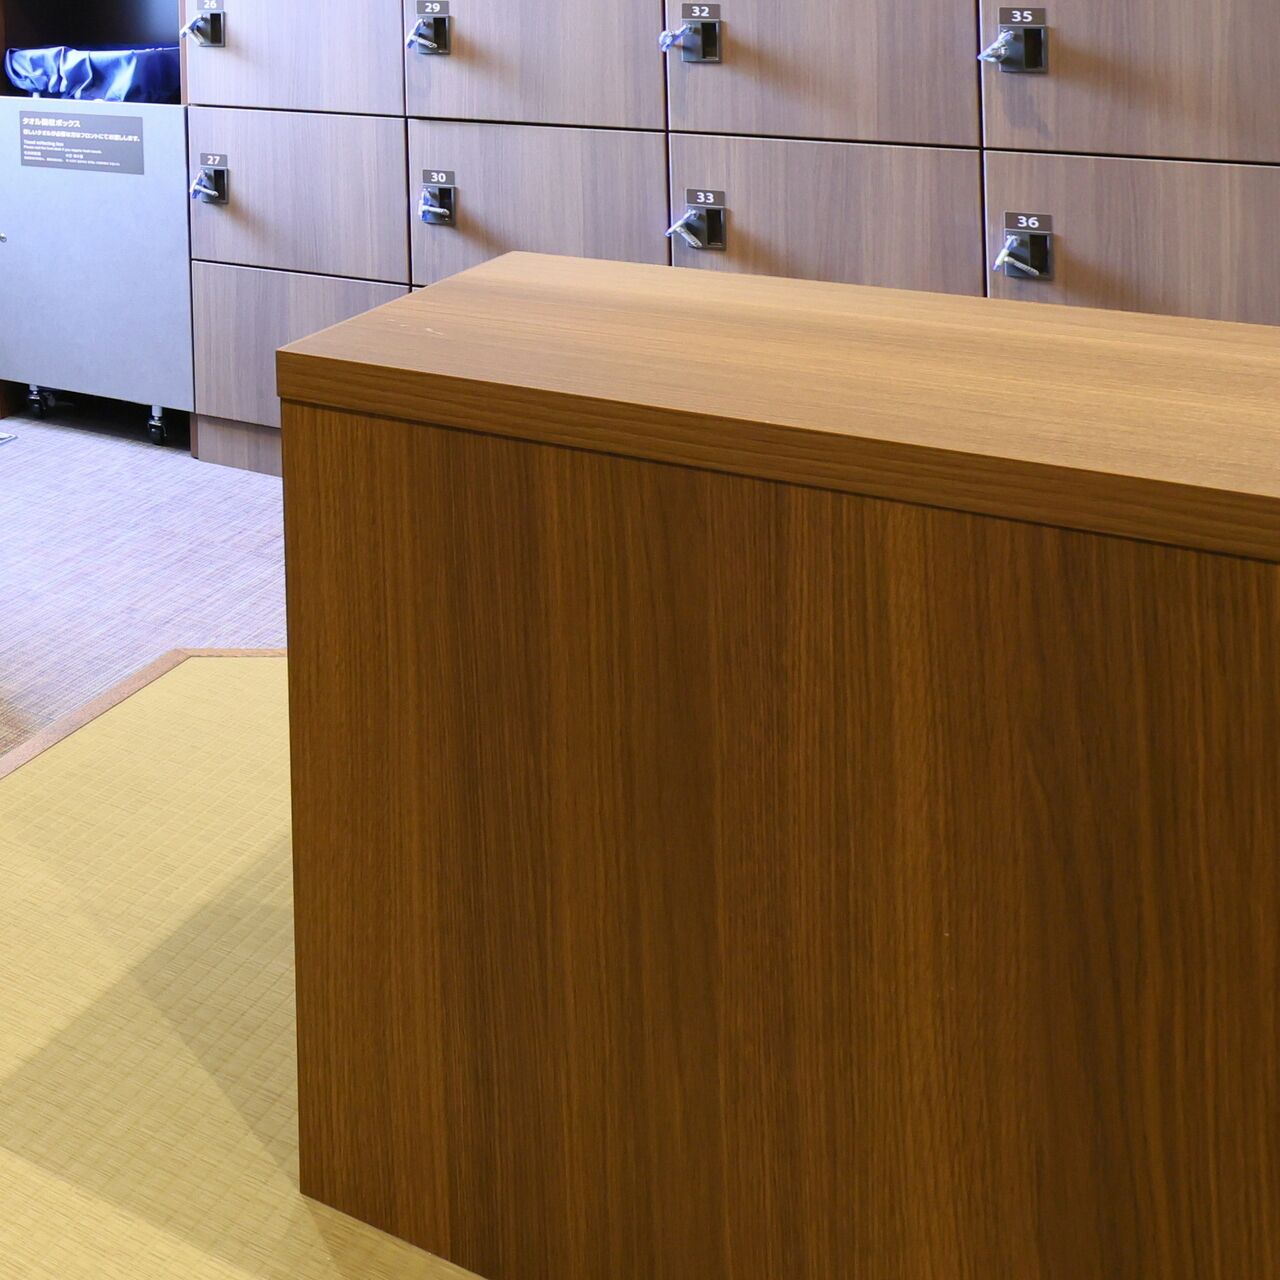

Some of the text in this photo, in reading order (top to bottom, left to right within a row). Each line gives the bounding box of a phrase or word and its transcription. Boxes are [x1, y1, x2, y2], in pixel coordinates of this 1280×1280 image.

[203, 0, 217, 10] 26
[424, 2, 441, 13] 29
[691, 5, 710, 17] 32
[1011, 10, 1033, 23] 35
[207, 155, 221, 165] 27
[430, 171, 447, 183] 30
[696, 191, 715, 204] 33
[1017, 215, 1040, 229] 36
